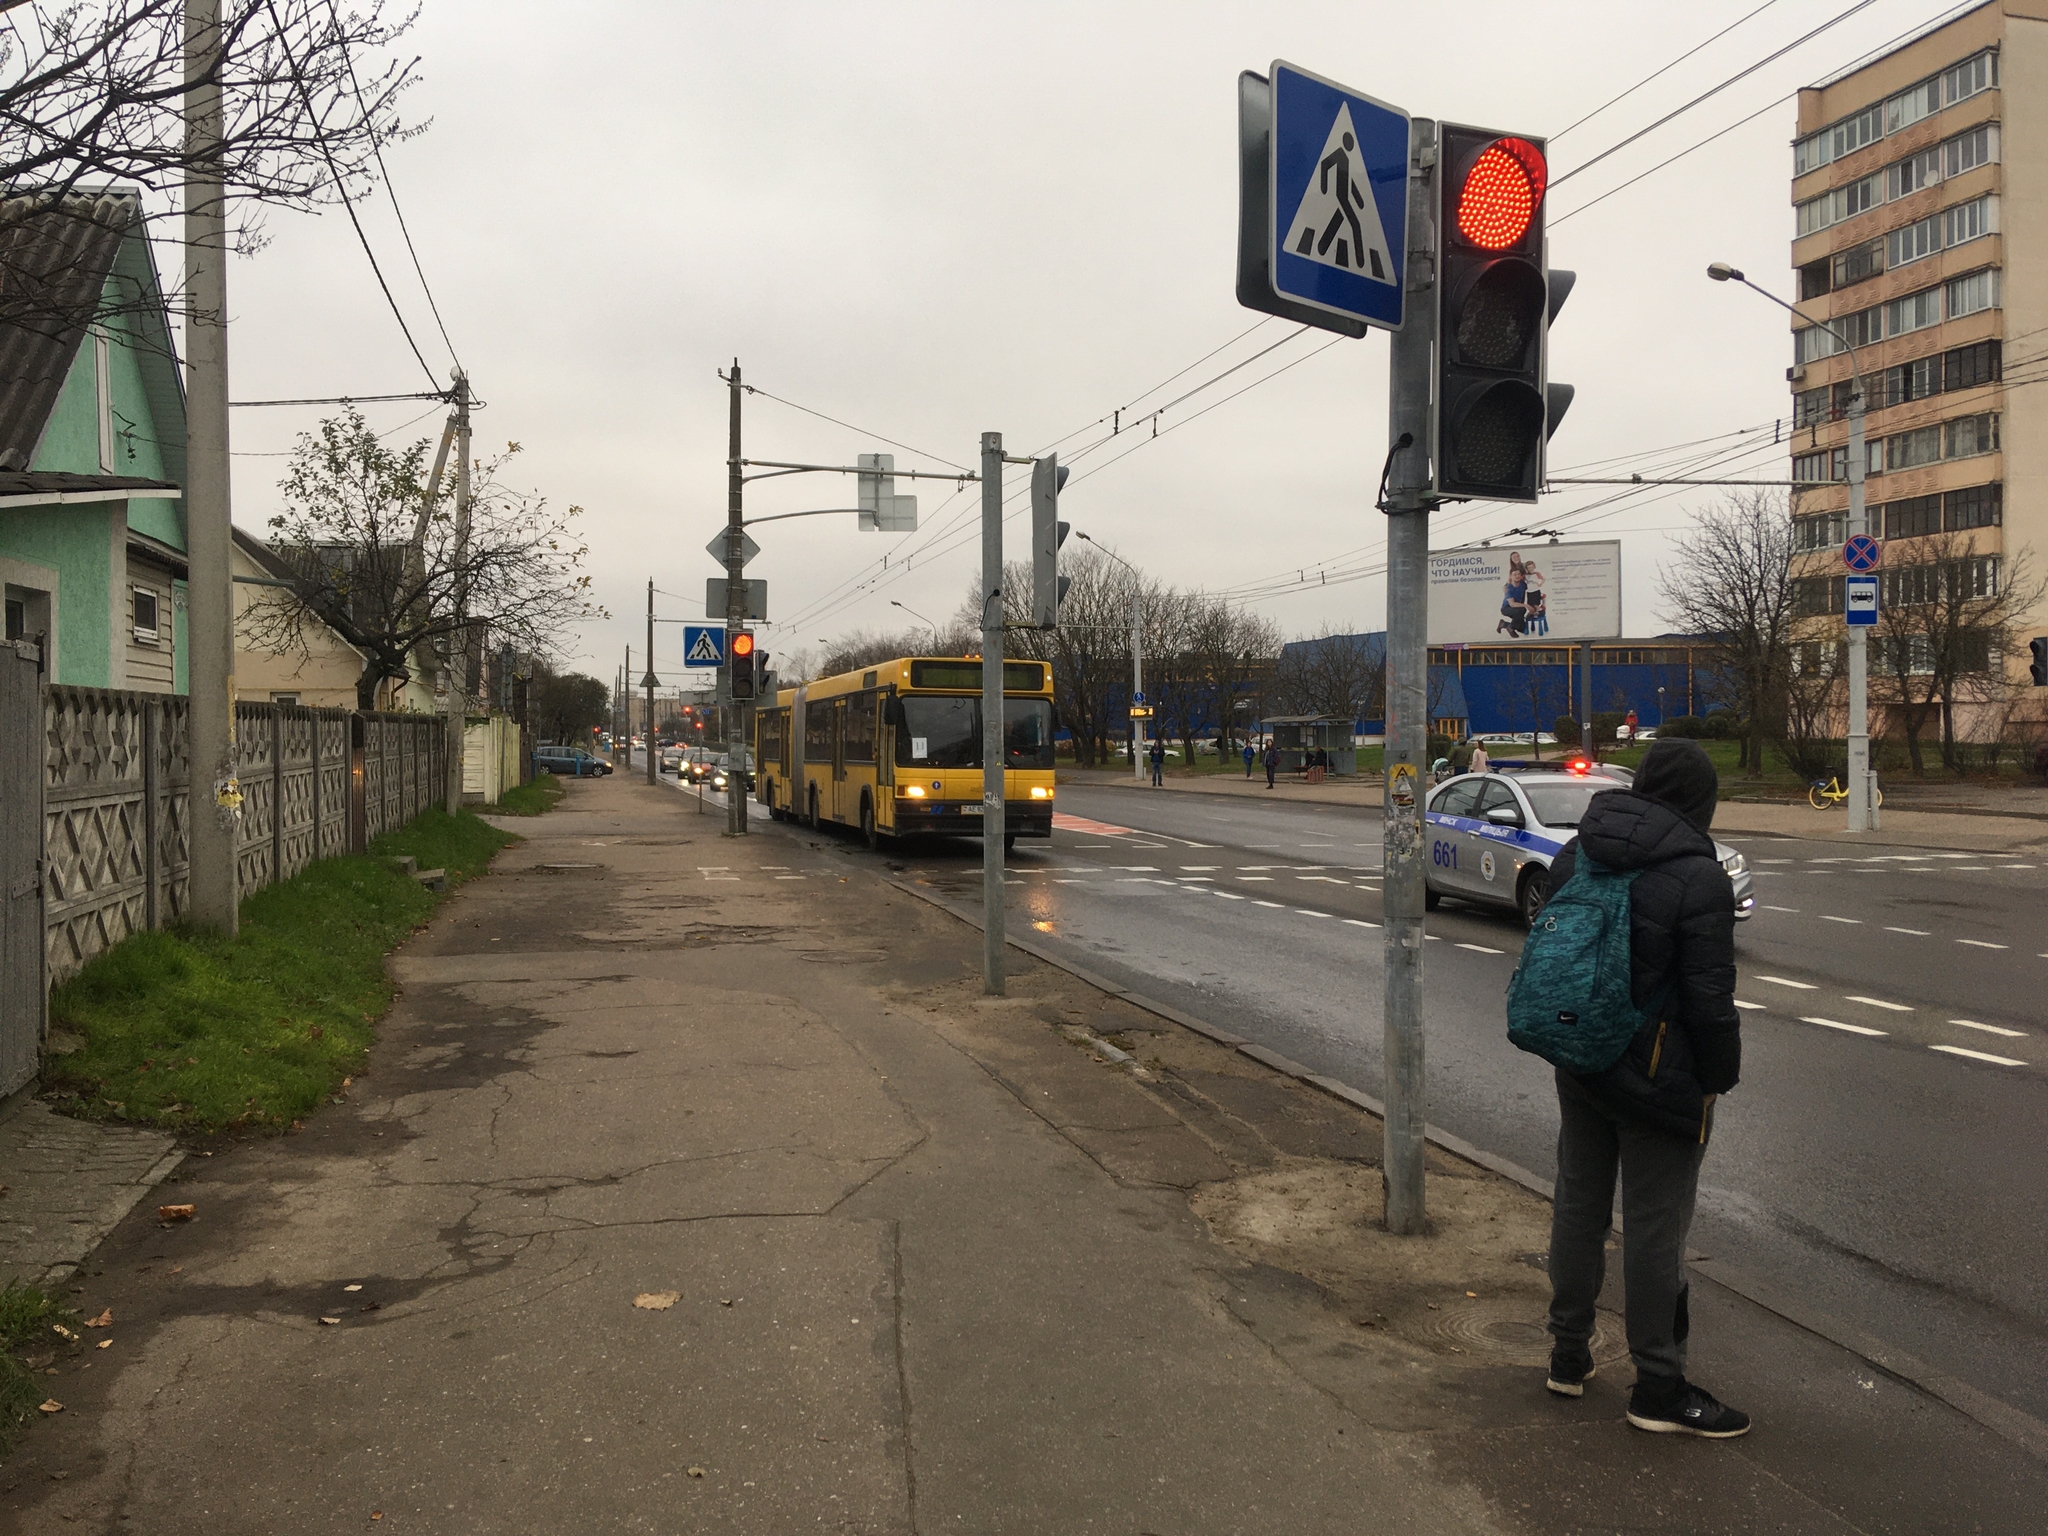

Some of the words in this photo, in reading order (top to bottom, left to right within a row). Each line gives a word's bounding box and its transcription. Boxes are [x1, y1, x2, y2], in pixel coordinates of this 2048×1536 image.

[1431, 557, 1485, 567] ГОРДИМСЯ,
[1431, 569, 1450, 577] ЧТО
[1452, 566, 1500, 576] НАУЧИЛИ!
[1433, 840, 1457, 870] 661
